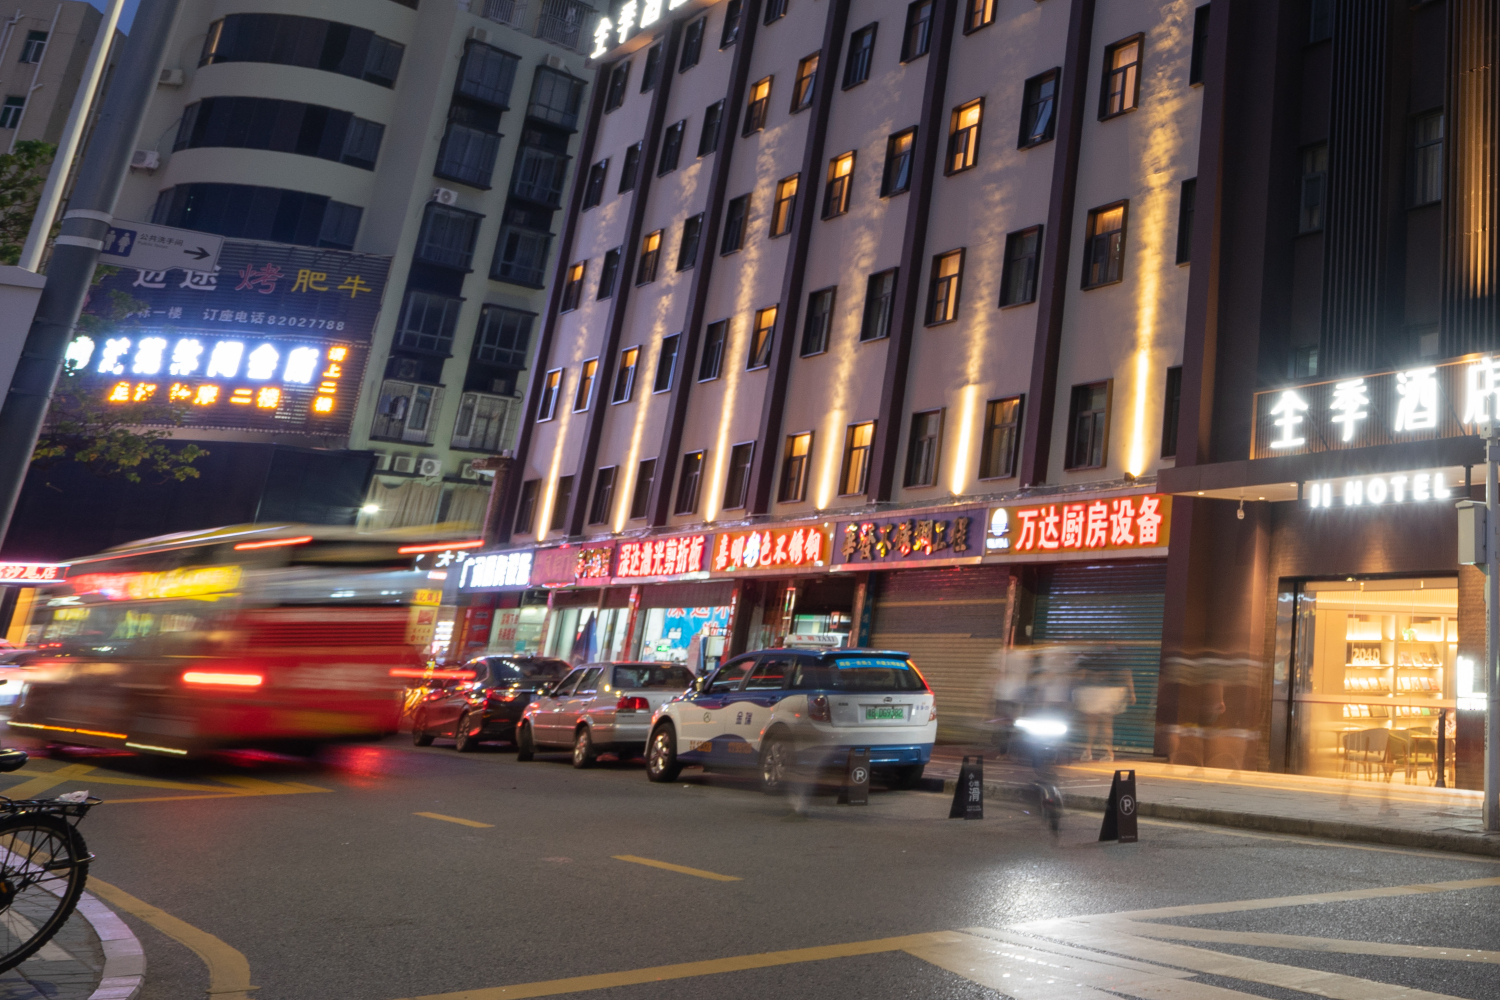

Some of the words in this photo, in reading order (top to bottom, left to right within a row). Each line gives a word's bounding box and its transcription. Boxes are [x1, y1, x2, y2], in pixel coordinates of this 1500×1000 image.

[140, 233, 184, 248] 公共洗手间
[203, 308, 345, 331] 订座电话82027788
[1344, 472, 1451, 505] HOTEL
[1015, 495, 1162, 551] 万达厨房设备
[617, 535, 705, 577] 深达激光剪折板
